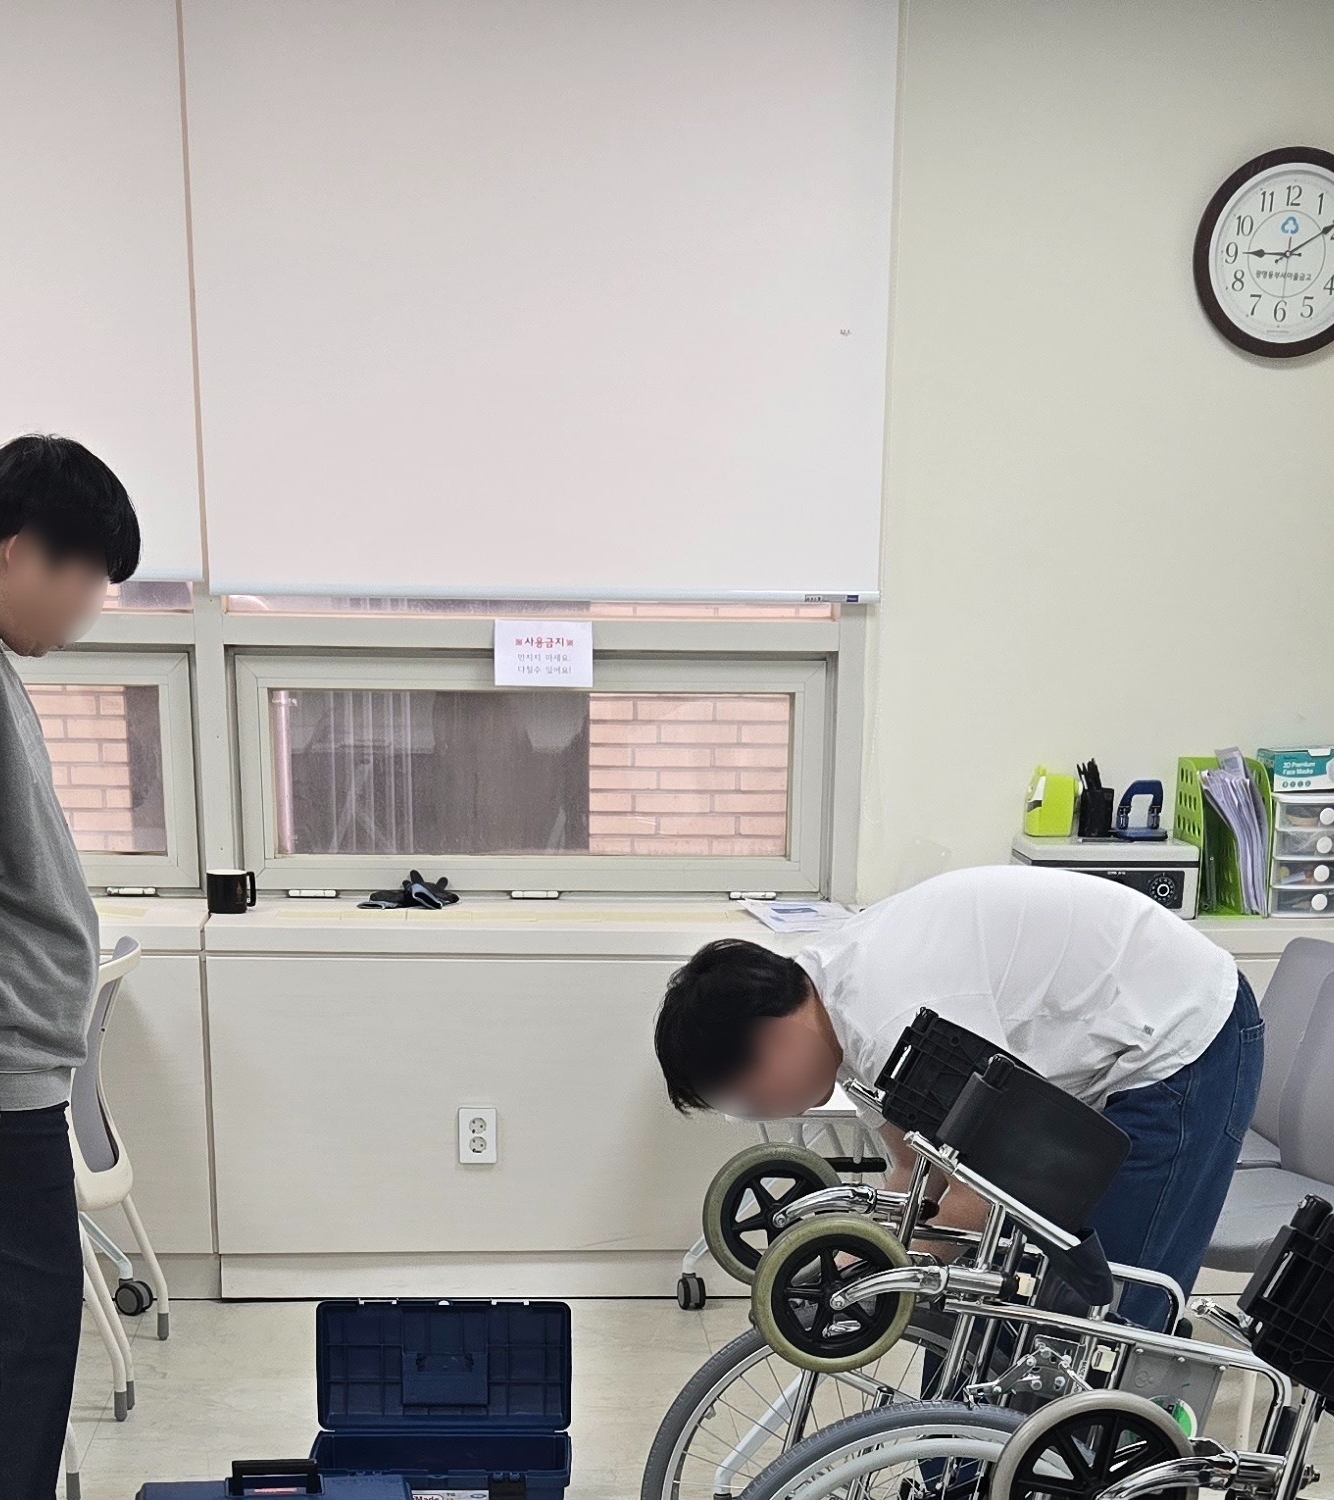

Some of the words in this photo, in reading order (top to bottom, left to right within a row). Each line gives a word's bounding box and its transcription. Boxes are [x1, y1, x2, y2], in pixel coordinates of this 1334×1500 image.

[1260, 190, 1275, 212] 11
[1285, 185, 1303, 207] 12
[1317, 192, 1325, 215] 1
[1235, 215, 1254, 237] 10
[1224, 241, 1239, 264] 9
[1231, 269, 1245, 292] 8
[1250, 294, 1262, 316] 7
[1273, 300, 1287, 323] 6
[1300, 296, 1314, 318] 5
[524, 637, 564, 649] 사용금지
